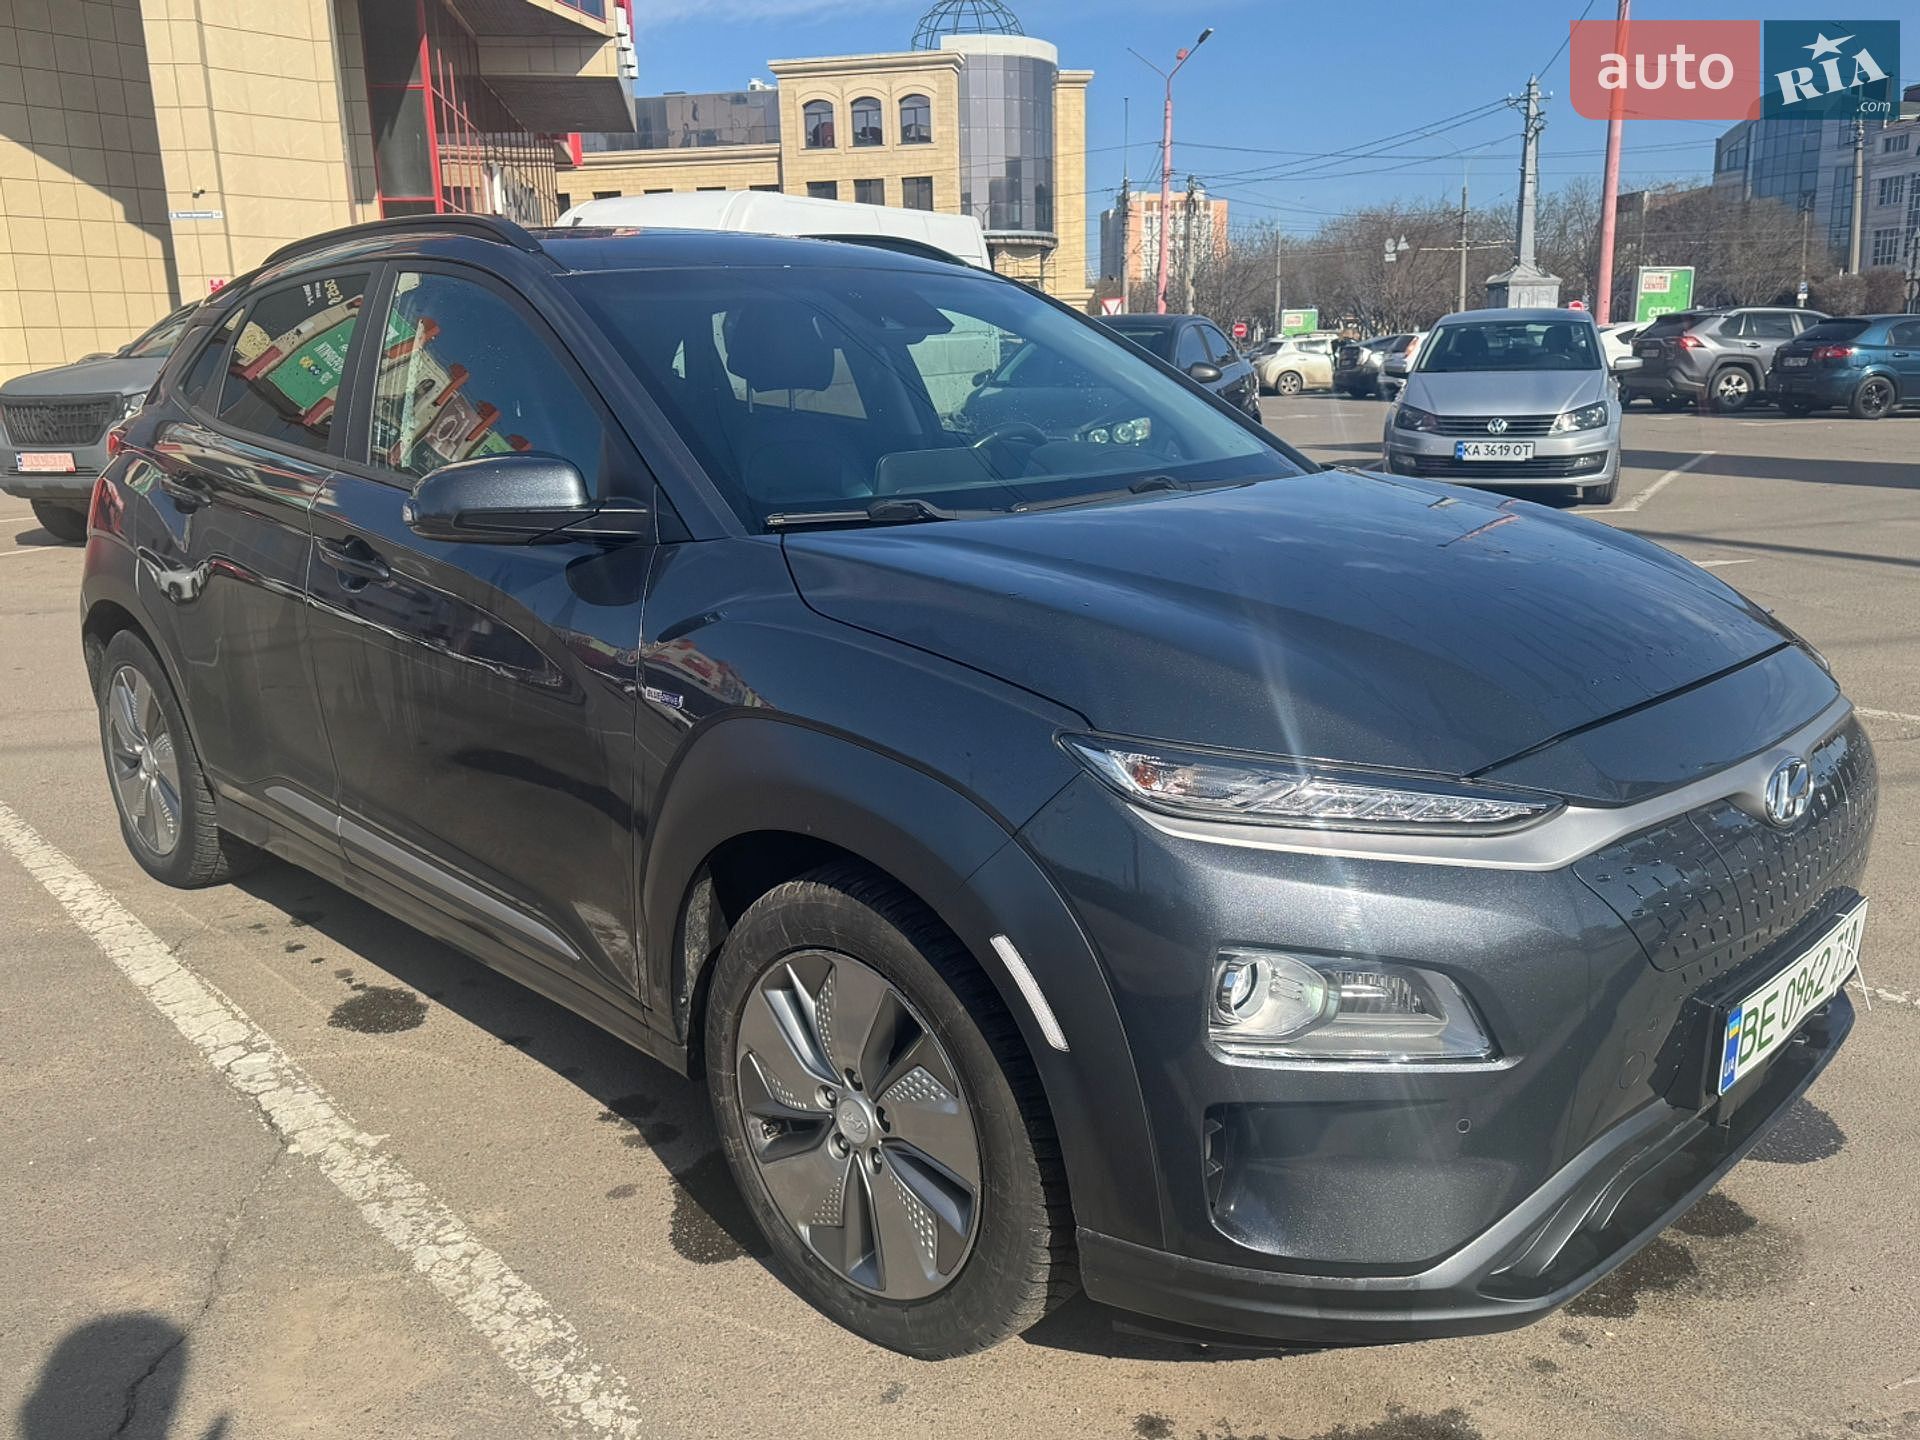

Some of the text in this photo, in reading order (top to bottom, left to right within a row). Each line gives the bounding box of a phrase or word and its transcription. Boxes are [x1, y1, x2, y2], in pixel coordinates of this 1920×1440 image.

[1464, 444, 1531, 456] KA 3619 OT
[1737, 990, 1779, 1068] BE
[1781, 946, 1831, 1030] 0962
